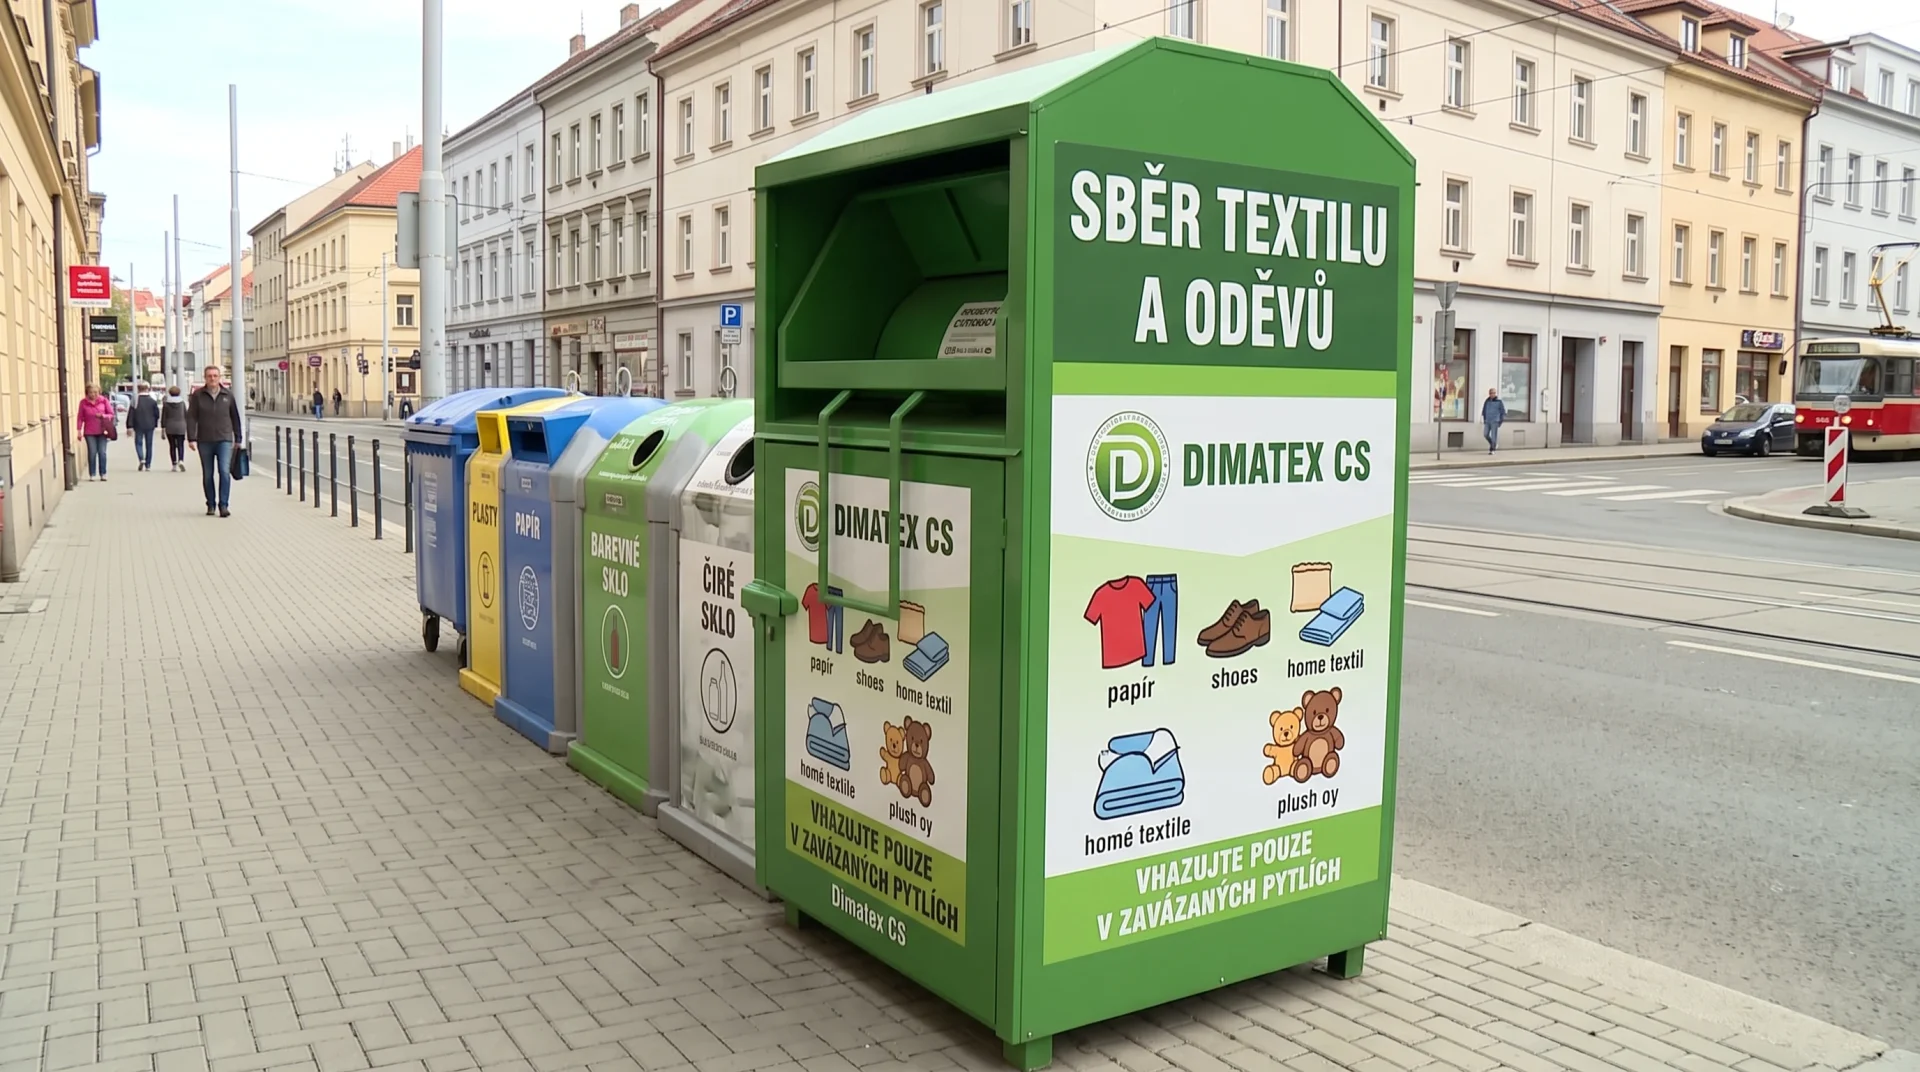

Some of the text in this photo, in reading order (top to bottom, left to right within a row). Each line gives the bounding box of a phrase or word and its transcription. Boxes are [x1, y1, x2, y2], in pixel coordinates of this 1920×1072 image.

[1070, 161, 1388, 267] SBĚR TEXTILU
[725, 307, 737, 325] P
[1134, 268, 1334, 351] A ODĚVŮ
[1183, 440, 1371, 487] DIMATEX CS
[472, 501, 498, 528] PLASTY
[515, 510, 541, 540] PAPÍR
[591, 531, 640, 568] BAREVNÉ
[926, 516, 954, 556] CS
[602, 567, 629, 598] SKLO
[703, 556, 735, 600] ČIRÉ
[701, 600, 735, 639] SKLO
[810, 656, 834, 676] papír
[856, 669, 884, 692] shoes
[1211, 667, 1258, 689] shoes
[1287, 649, 1364, 678] home textil
[896, 680, 952, 715] home textil
[1107, 676, 1155, 708] papír
[800, 758, 824, 785] homé
[889, 801, 933, 838] plush oy
[1278, 787, 1339, 819] plush oy
[811, 799, 933, 882] VHAZUJTE POUZE
[1085, 817, 1191, 856] homé textile
[790, 822, 959, 934] V ZAVÁZANÝCH PYTLÍCH
[1136, 829, 1313, 894] VHAZUJTE POUZE
[831, 883, 907, 947] Dimatex CS
[1097, 857, 1341, 941] V ZAVÁZANÝCH PYTLÍCH
